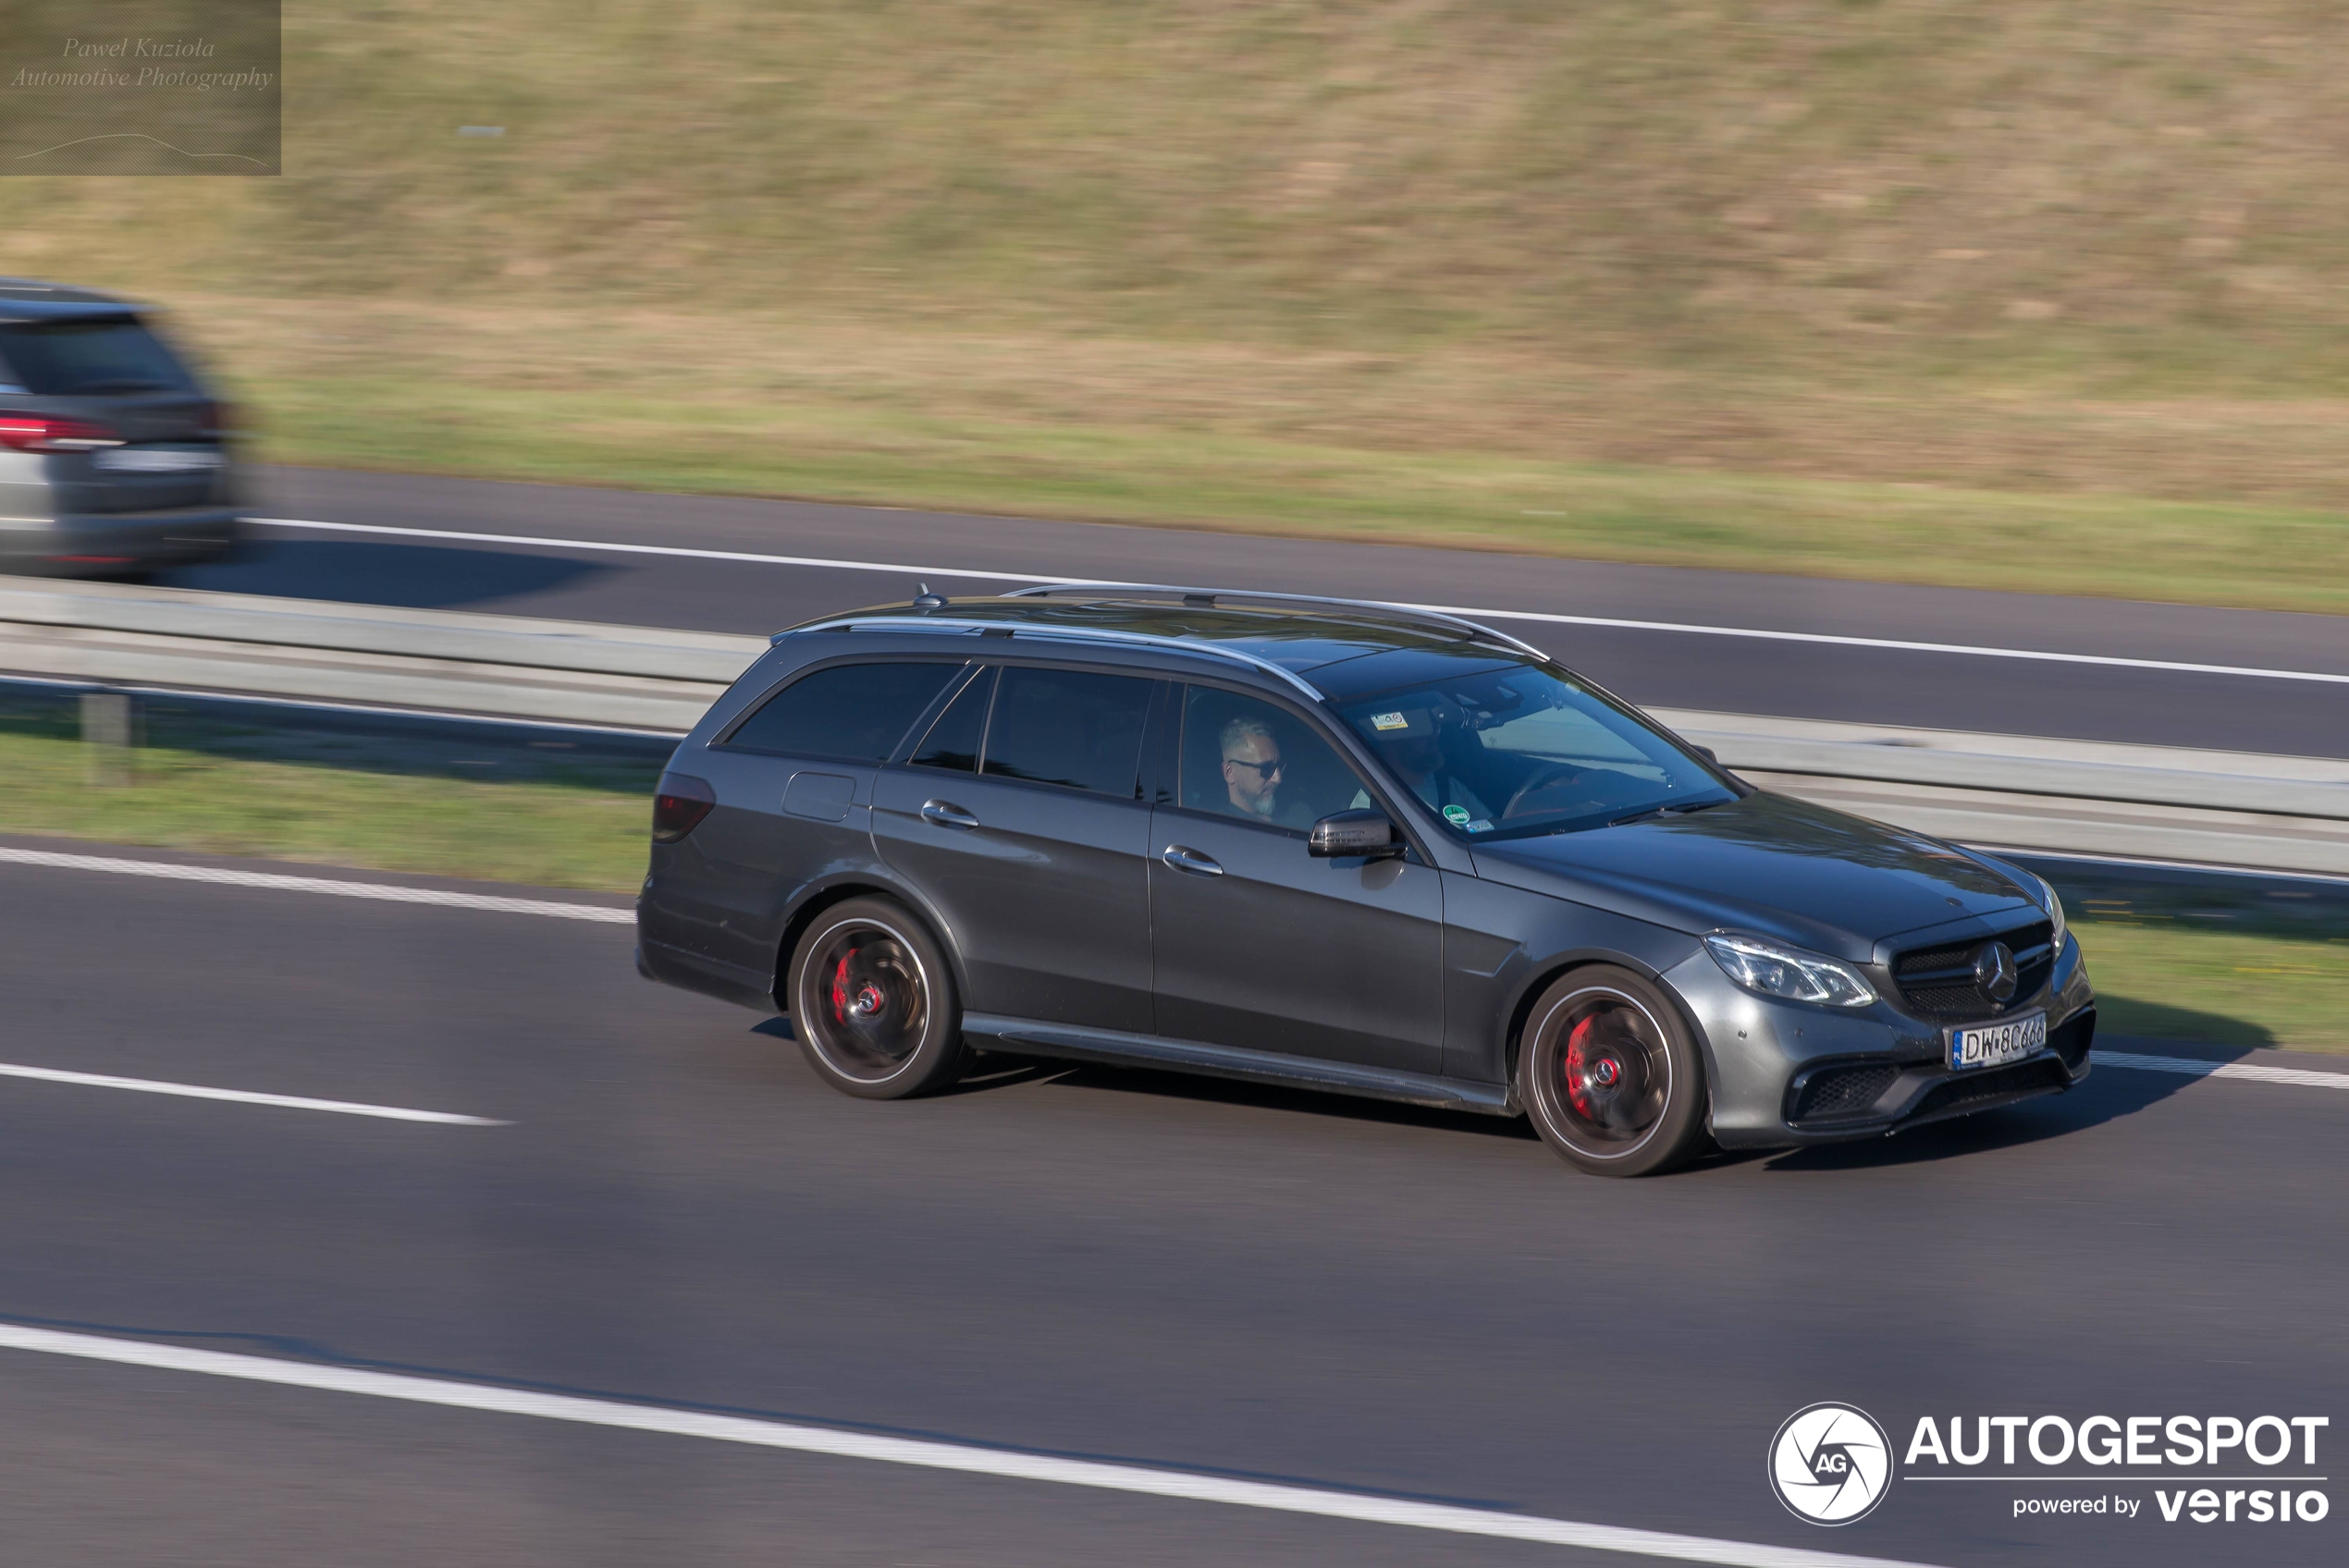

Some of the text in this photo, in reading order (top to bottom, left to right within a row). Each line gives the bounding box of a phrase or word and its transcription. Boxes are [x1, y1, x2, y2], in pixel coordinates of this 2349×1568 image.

[1966, 1016, 2044, 1060] DW 8C666
[1953, 1052, 1961, 1060] PL
